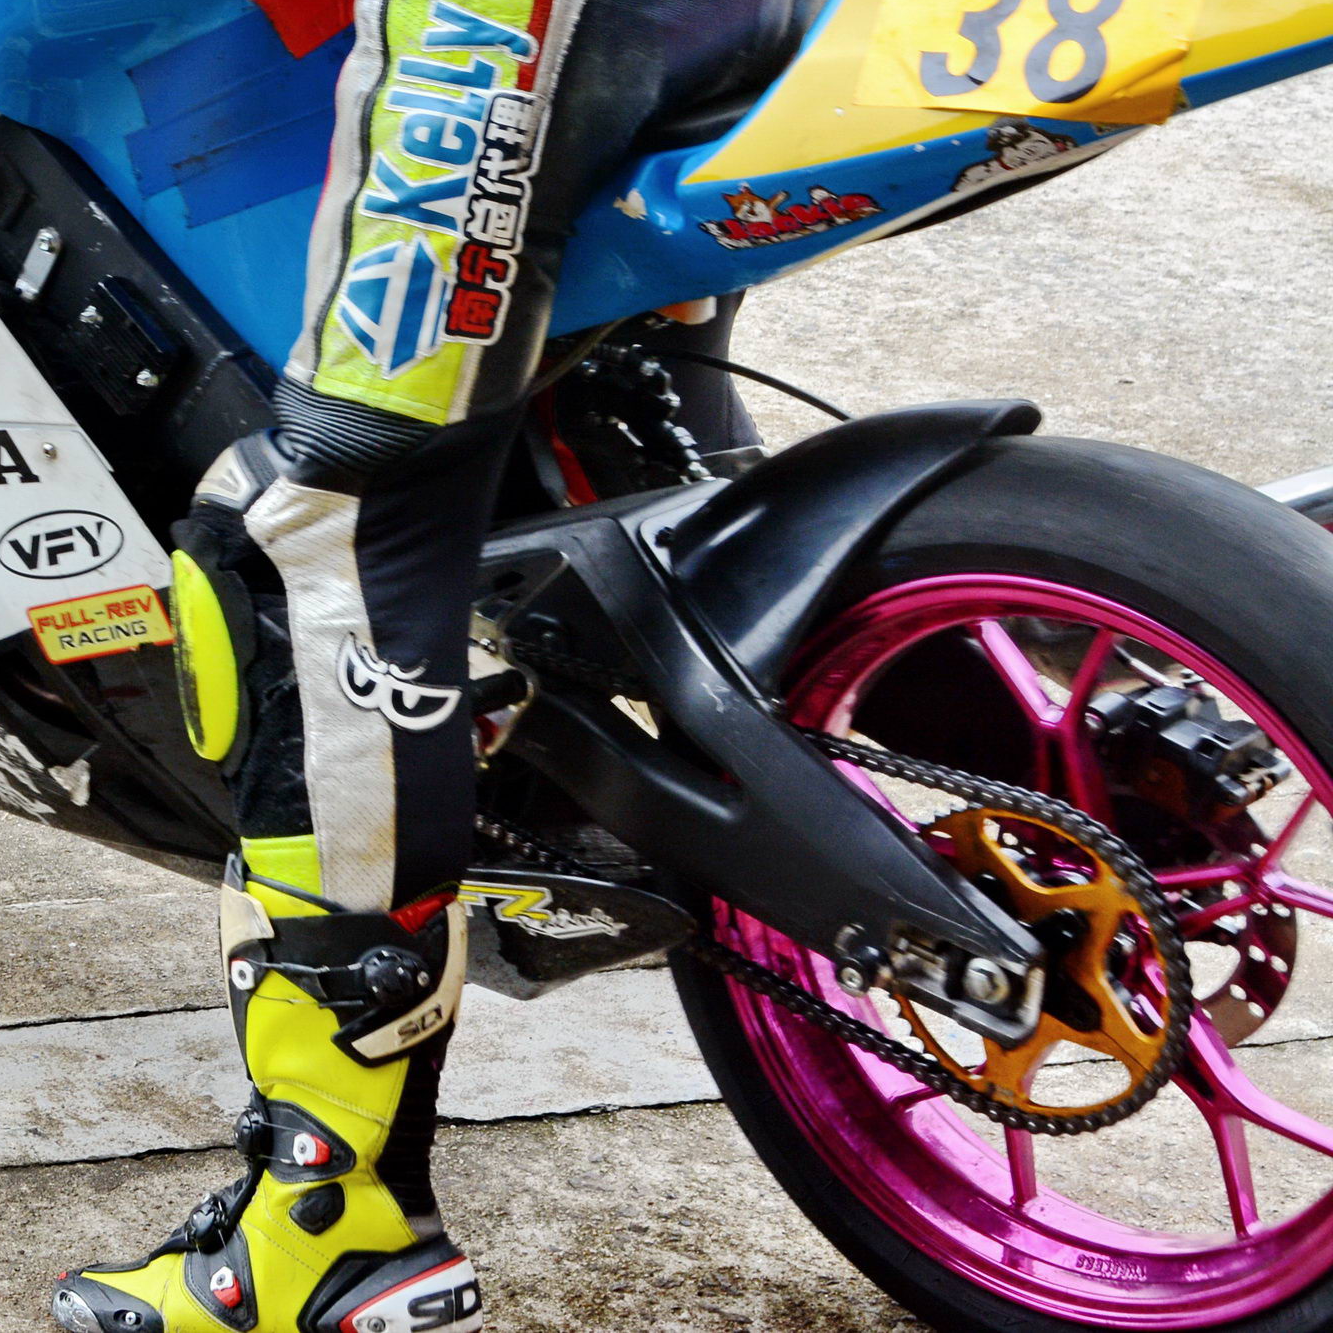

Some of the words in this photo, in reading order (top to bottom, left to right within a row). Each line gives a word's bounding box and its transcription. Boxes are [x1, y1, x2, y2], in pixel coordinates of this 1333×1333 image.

[361, 0, 535, 236] Kelly
[7, 521, 104, 570] VFY
[36, 595, 154, 635] FULL-REV
[58, 619, 148, 650] RACING
